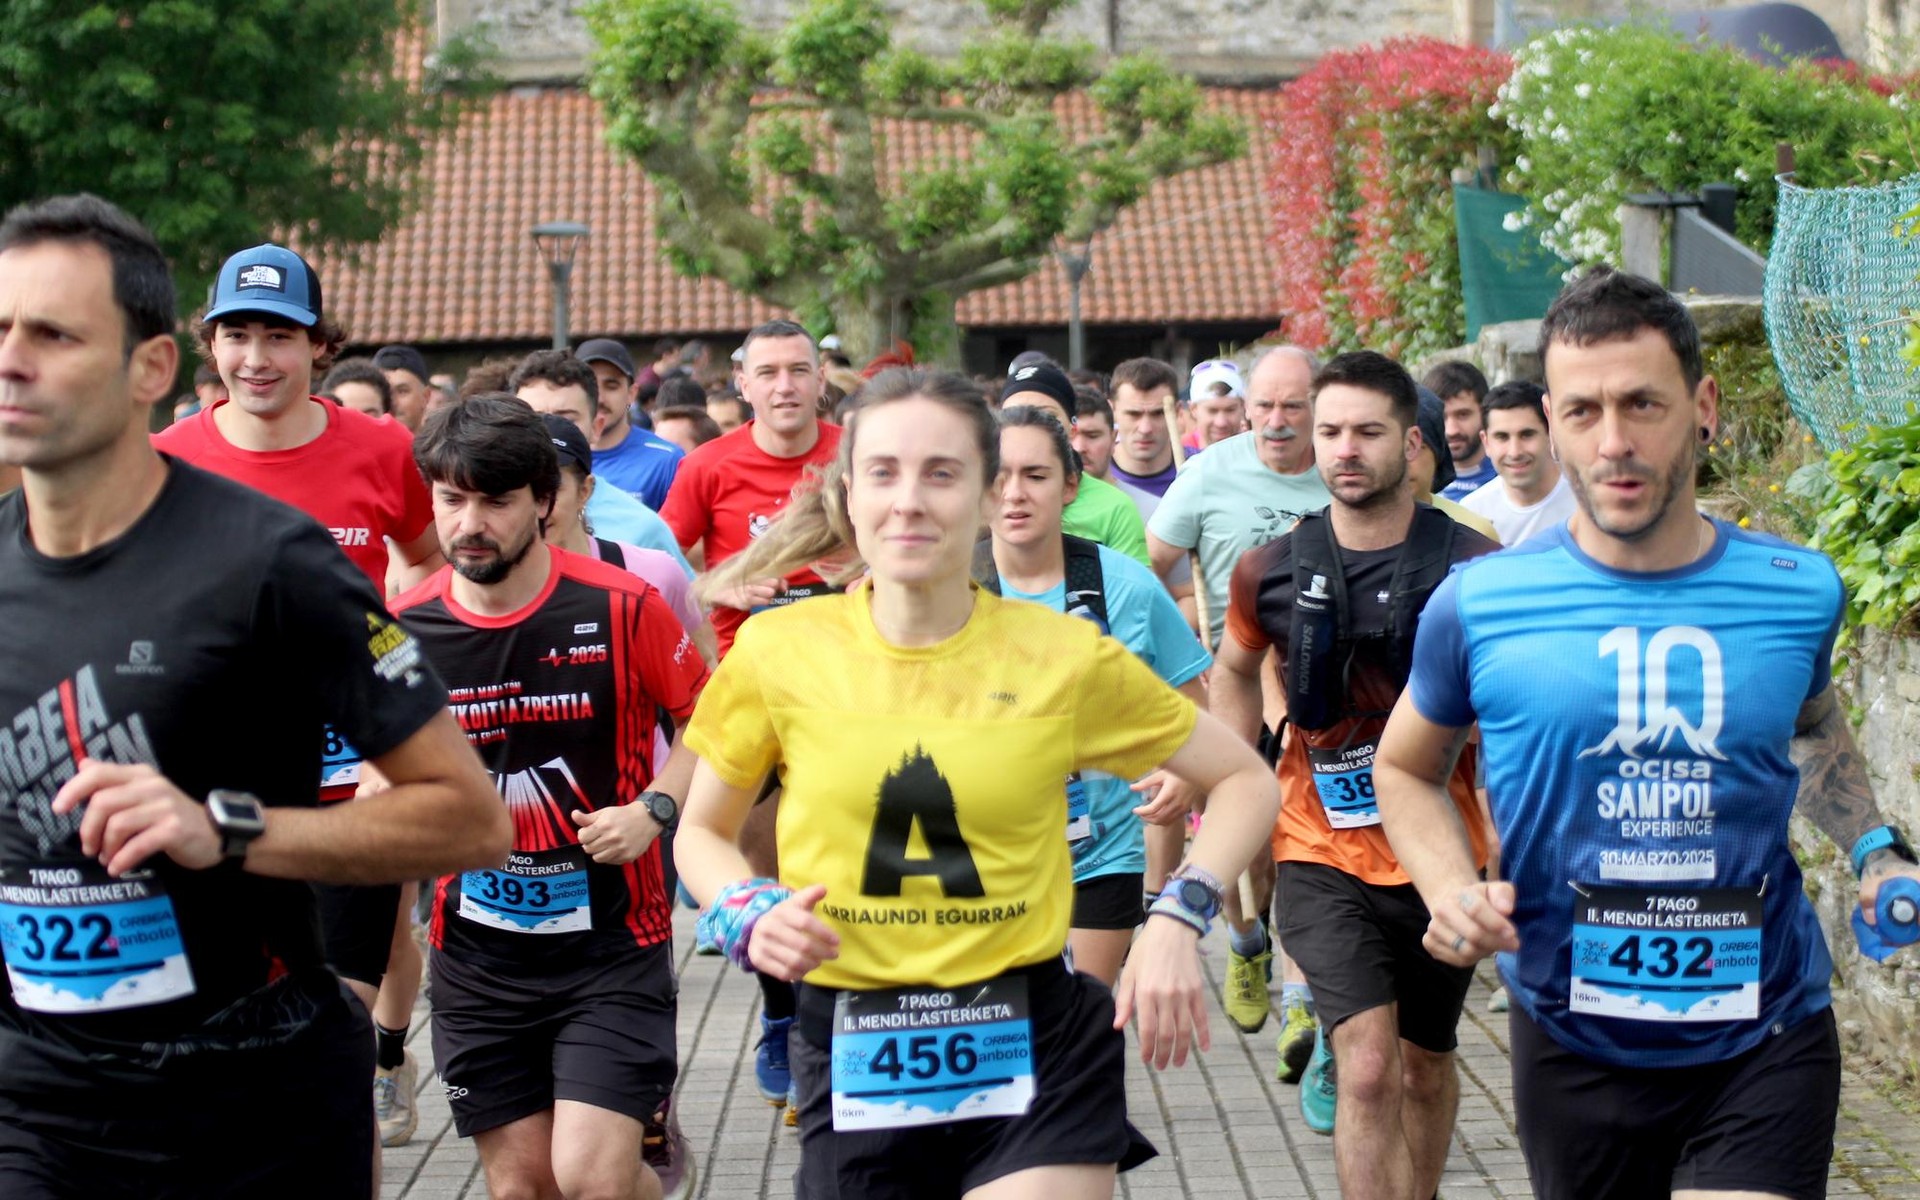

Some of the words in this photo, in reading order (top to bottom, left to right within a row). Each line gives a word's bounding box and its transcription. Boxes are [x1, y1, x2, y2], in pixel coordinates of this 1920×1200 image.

[789, 588, 811, 597] PAGO
[568, 644, 608, 665] 2025
[1299, 623, 1313, 695] SALOMON
[1594, 625, 1726, 759] 10
[1346, 745, 1374, 760] PAGO
[1597, 782, 1716, 819] SAMPOL
[1621, 820, 1712, 838] EXPERIENCE
[504, 861, 574, 876] LASTERKETA
[507, 855, 533, 866] AGO
[29, 869, 38, 885] 7
[39, 869, 81, 886] PAGO
[2, 885, 42, 902] MENDI
[42, 882, 146, 905] LASTERKETA
[481, 871, 551, 908] 393
[551, 888, 587, 900] anboto
[822, 903, 926, 924] ARRIAUNDI
[935, 901, 1026, 925] EGURRAK
[1646, 898, 1656, 911] 7
[1657, 898, 1698, 911] PAGO
[1602, 910, 1652, 926] MENDI
[1654, 912, 1747, 927] LASTERKETA
[17, 913, 120, 961] 322
[119, 927, 176, 947] anboto
[1719, 941, 1759, 953] ORBEA
[1608, 935, 1714, 979] 432
[1714, 955, 1758, 969] anboto
[898, 995, 907, 1009] 7
[909, 993, 953, 1009] PAGO
[1573, 993, 1601, 1004] 16km
[843, 1017, 856, 1031] II.
[857, 1012, 907, 1029] MENDI
[909, 1003, 1012, 1026] LASTERKETA
[982, 1033, 1028, 1047] ORBEA
[868, 1032, 978, 1081] 456
[978, 1046, 1029, 1063] anboto
[836, 1108, 866, 1118] 16km
